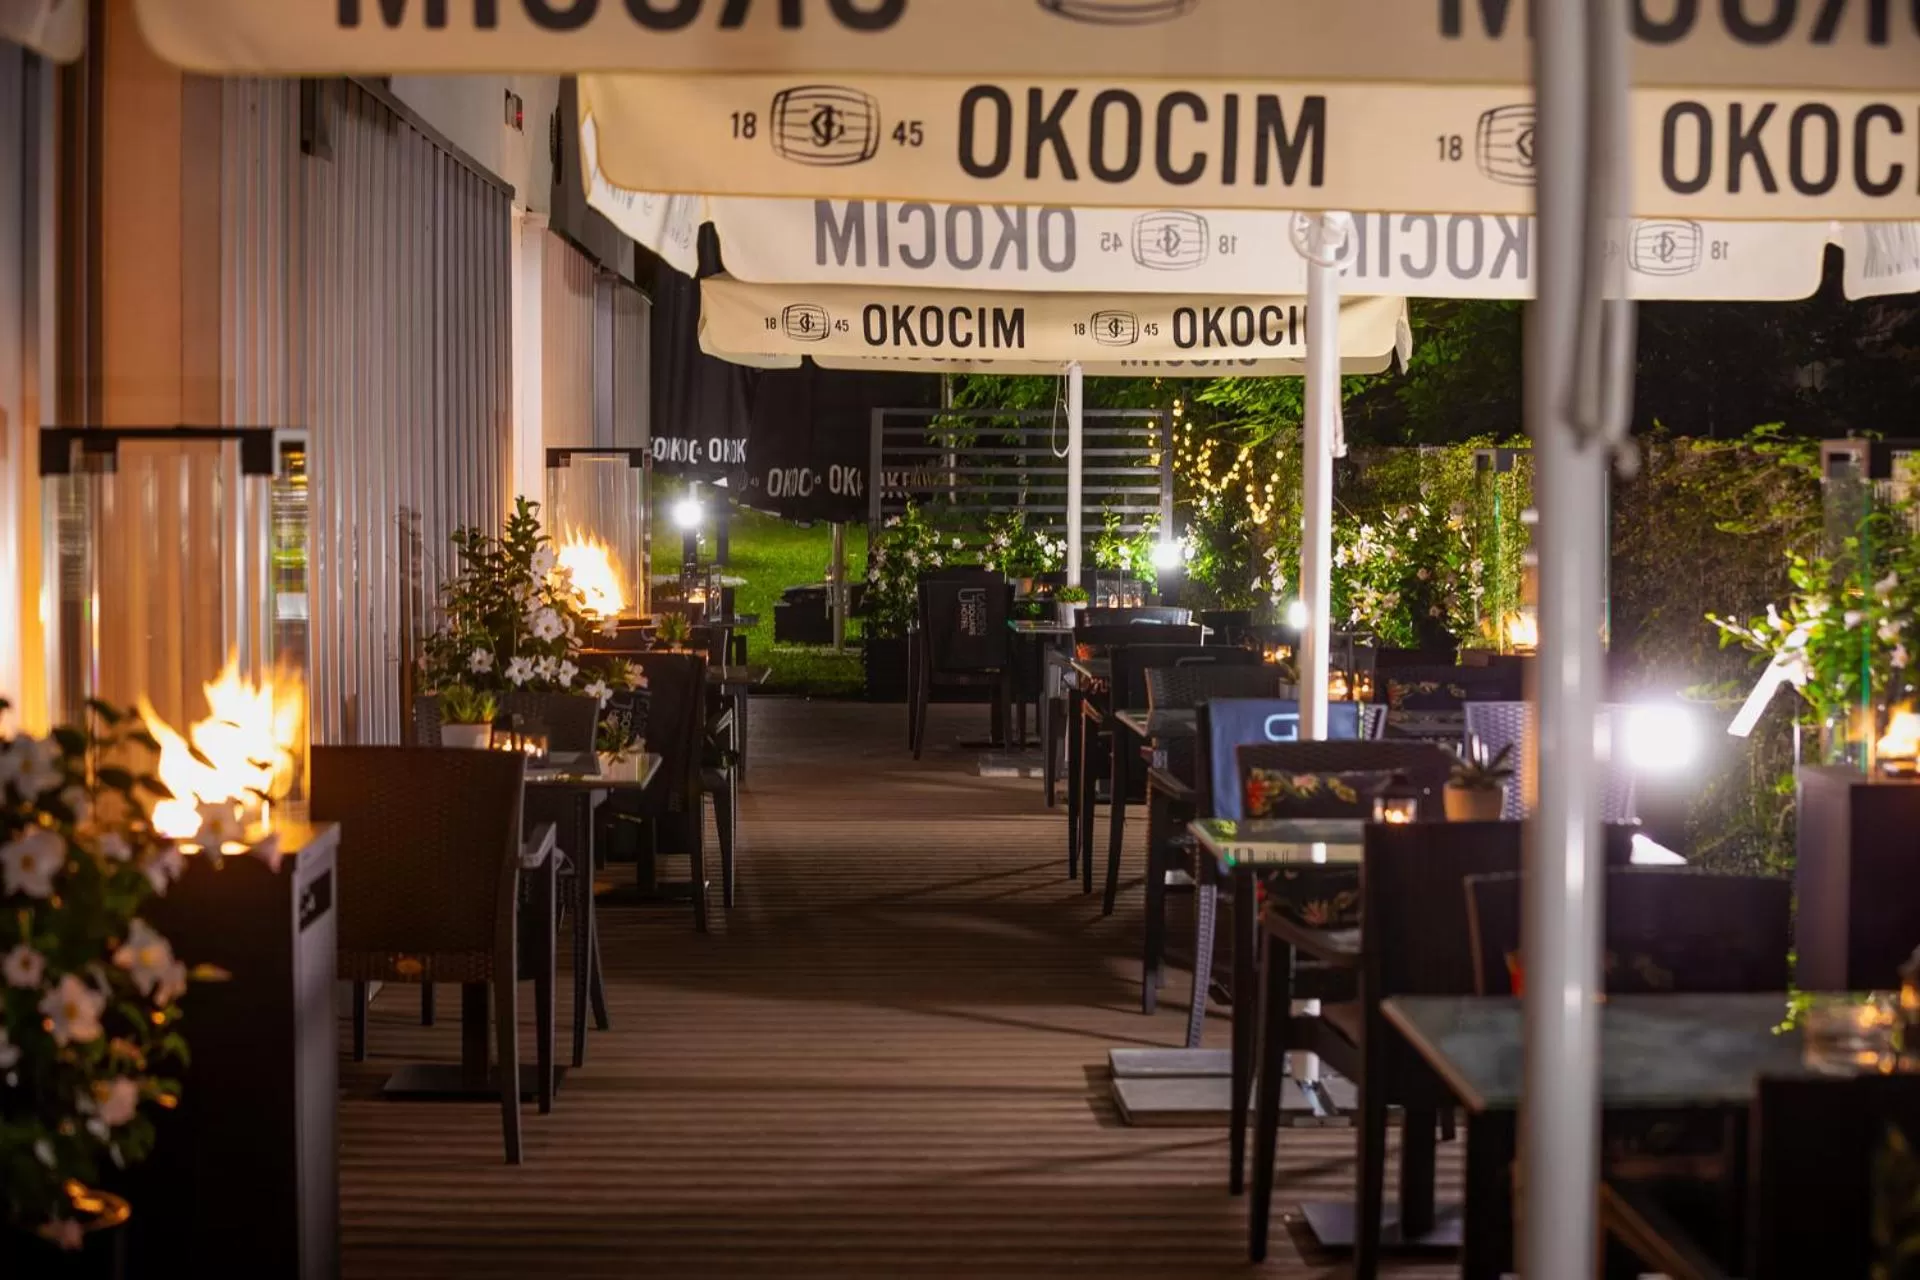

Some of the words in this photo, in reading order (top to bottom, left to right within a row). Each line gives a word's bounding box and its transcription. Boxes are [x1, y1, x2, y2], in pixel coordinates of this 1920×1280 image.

[731, 112, 757, 139] 18
[891, 119, 925, 148] 45
[957, 83, 1326, 188] OKOCIM
[1437, 135, 1463, 161] 18
[1661, 100, 1920, 198] OKOC
[764, 316, 777, 330] 18
[834, 319, 850, 333] 45
[862, 303, 1025, 349] OKOCIM
[1072, 322, 1086, 336] 18
[1143, 323, 1159, 336] 45
[1172, 305, 1306, 349] OKOCI
